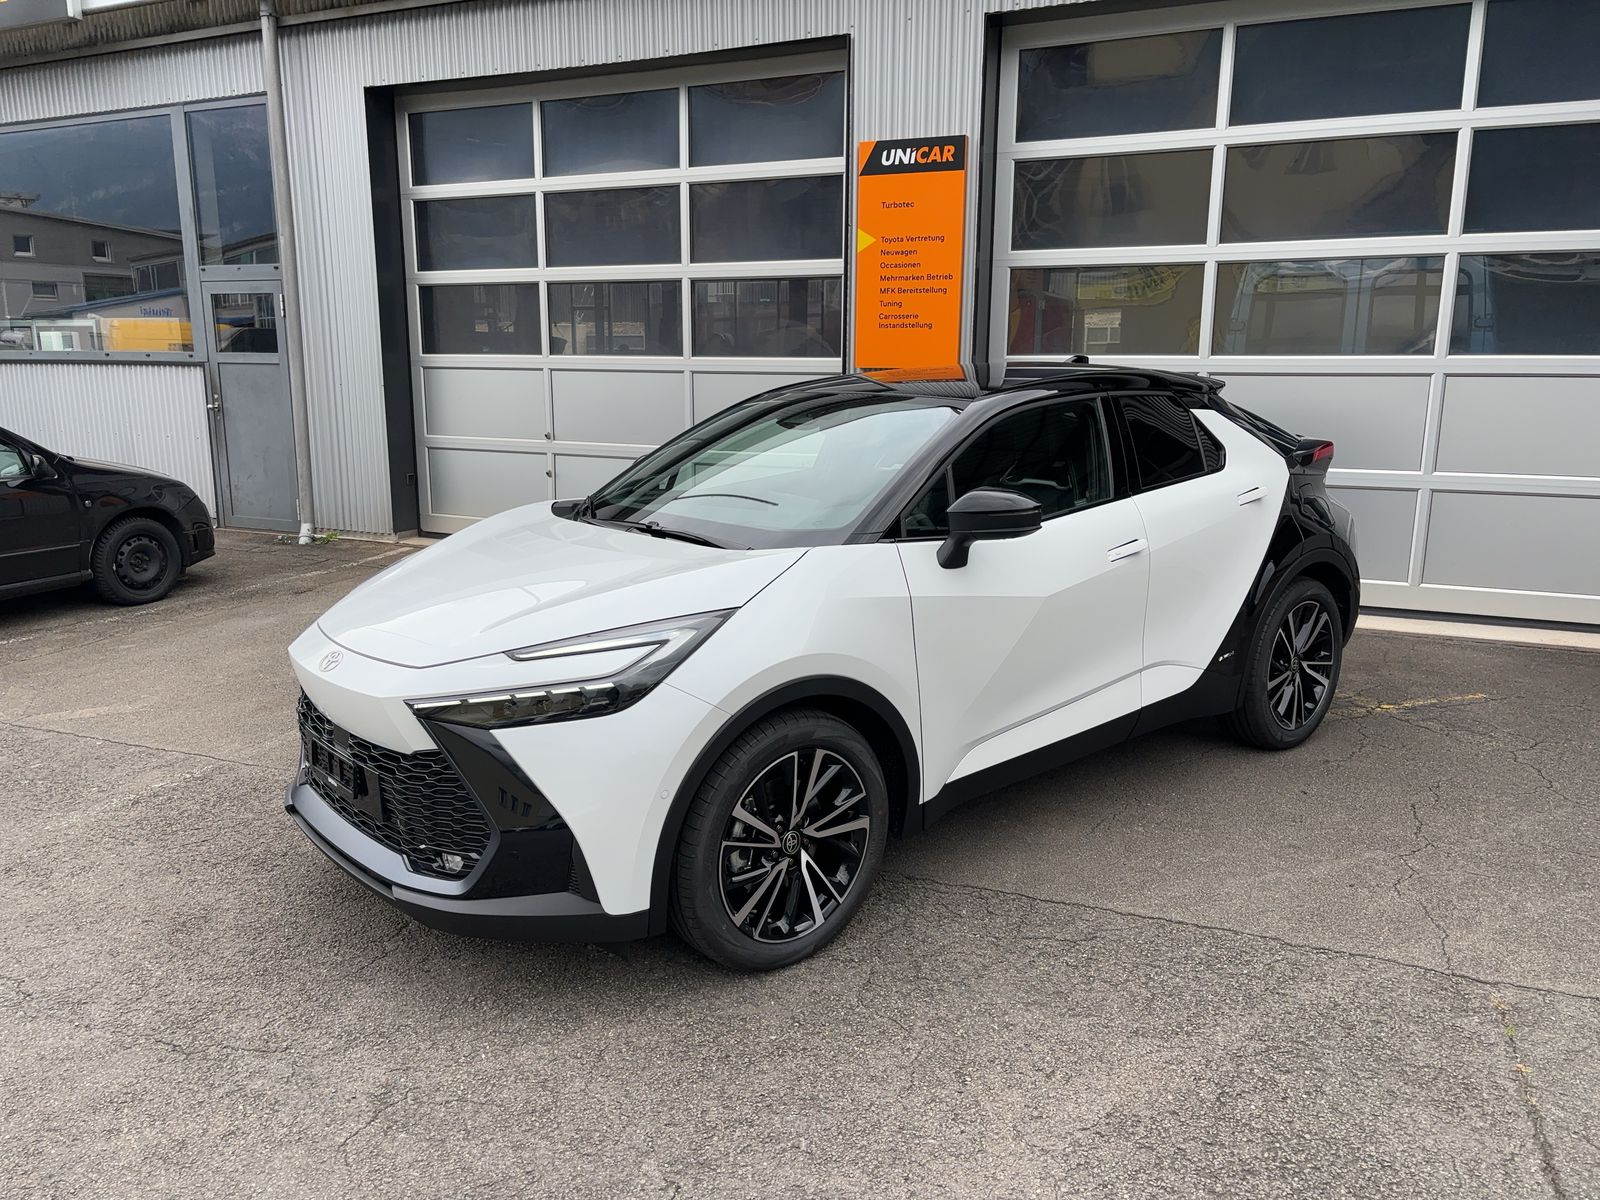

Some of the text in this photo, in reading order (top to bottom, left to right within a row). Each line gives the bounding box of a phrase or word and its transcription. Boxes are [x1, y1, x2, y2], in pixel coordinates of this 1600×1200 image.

[881, 145, 955, 166] UNiCAR
[881, 201, 915, 209] Turbotec
[881, 234, 945, 244] Toyota Vertretung
[880, 249, 918, 257] Neuwagen
[880, 261, 921, 269] Occasionen
[880, 274, 925, 282] Mehrmarken
[897, 286, 947, 295] Bereitstellung
[880, 300, 903, 308] Tuning
[879, 322, 932, 330] Instandstellung
